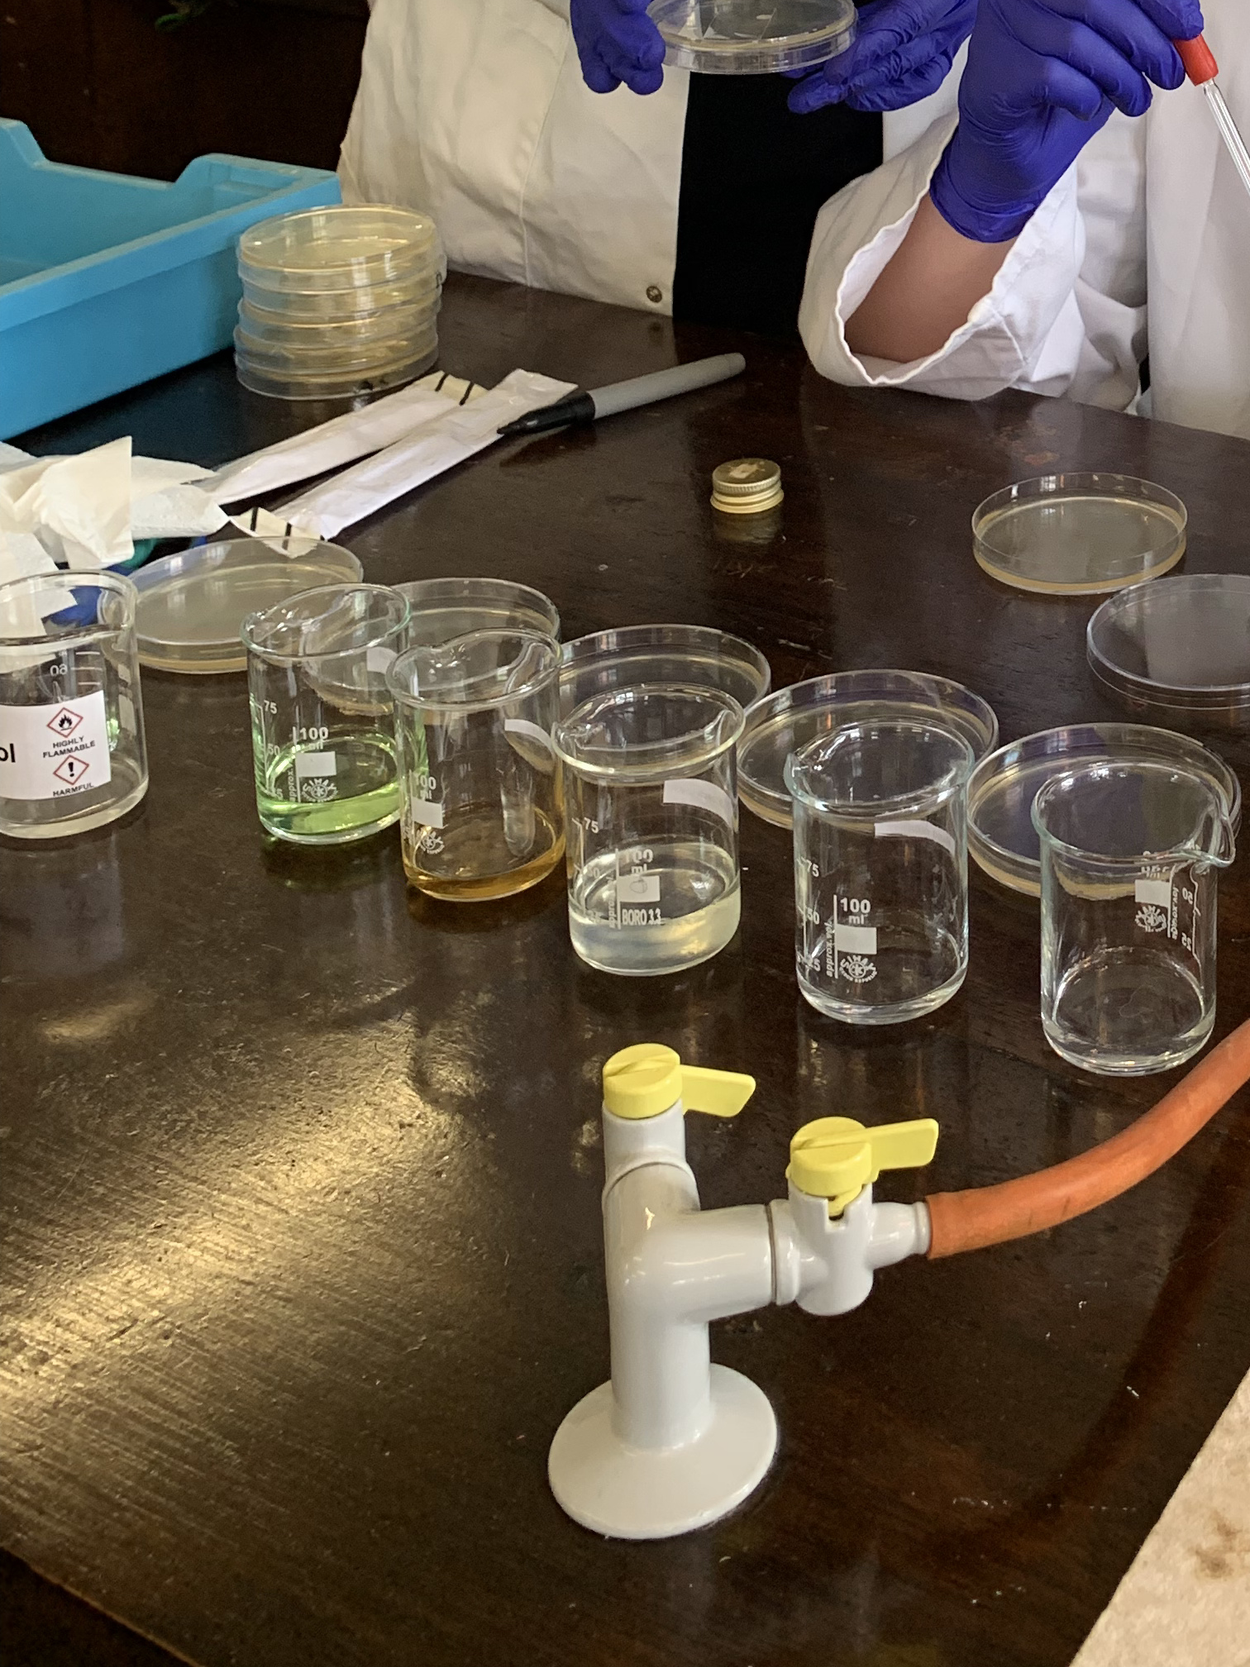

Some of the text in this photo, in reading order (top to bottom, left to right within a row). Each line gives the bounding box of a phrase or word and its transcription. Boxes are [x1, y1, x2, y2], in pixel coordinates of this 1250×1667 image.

[264, 700, 278, 715] 75
[301, 726, 329, 741] 100
[43, 740, 95, 758] FLAMMABLE
[53, 736, 84, 748] HIGHLY
[53, 783, 94, 796] HARMFUL
[584, 817, 599, 833] 75
[624, 849, 654, 864] 100
[801, 857, 820, 878] 75
[840, 897, 871, 914] 100
[621, 908, 648, 926] BORO
[648, 907, 661, 926] 3.3
[805, 907, 820, 925] 50
[848, 914, 865, 925] ml
